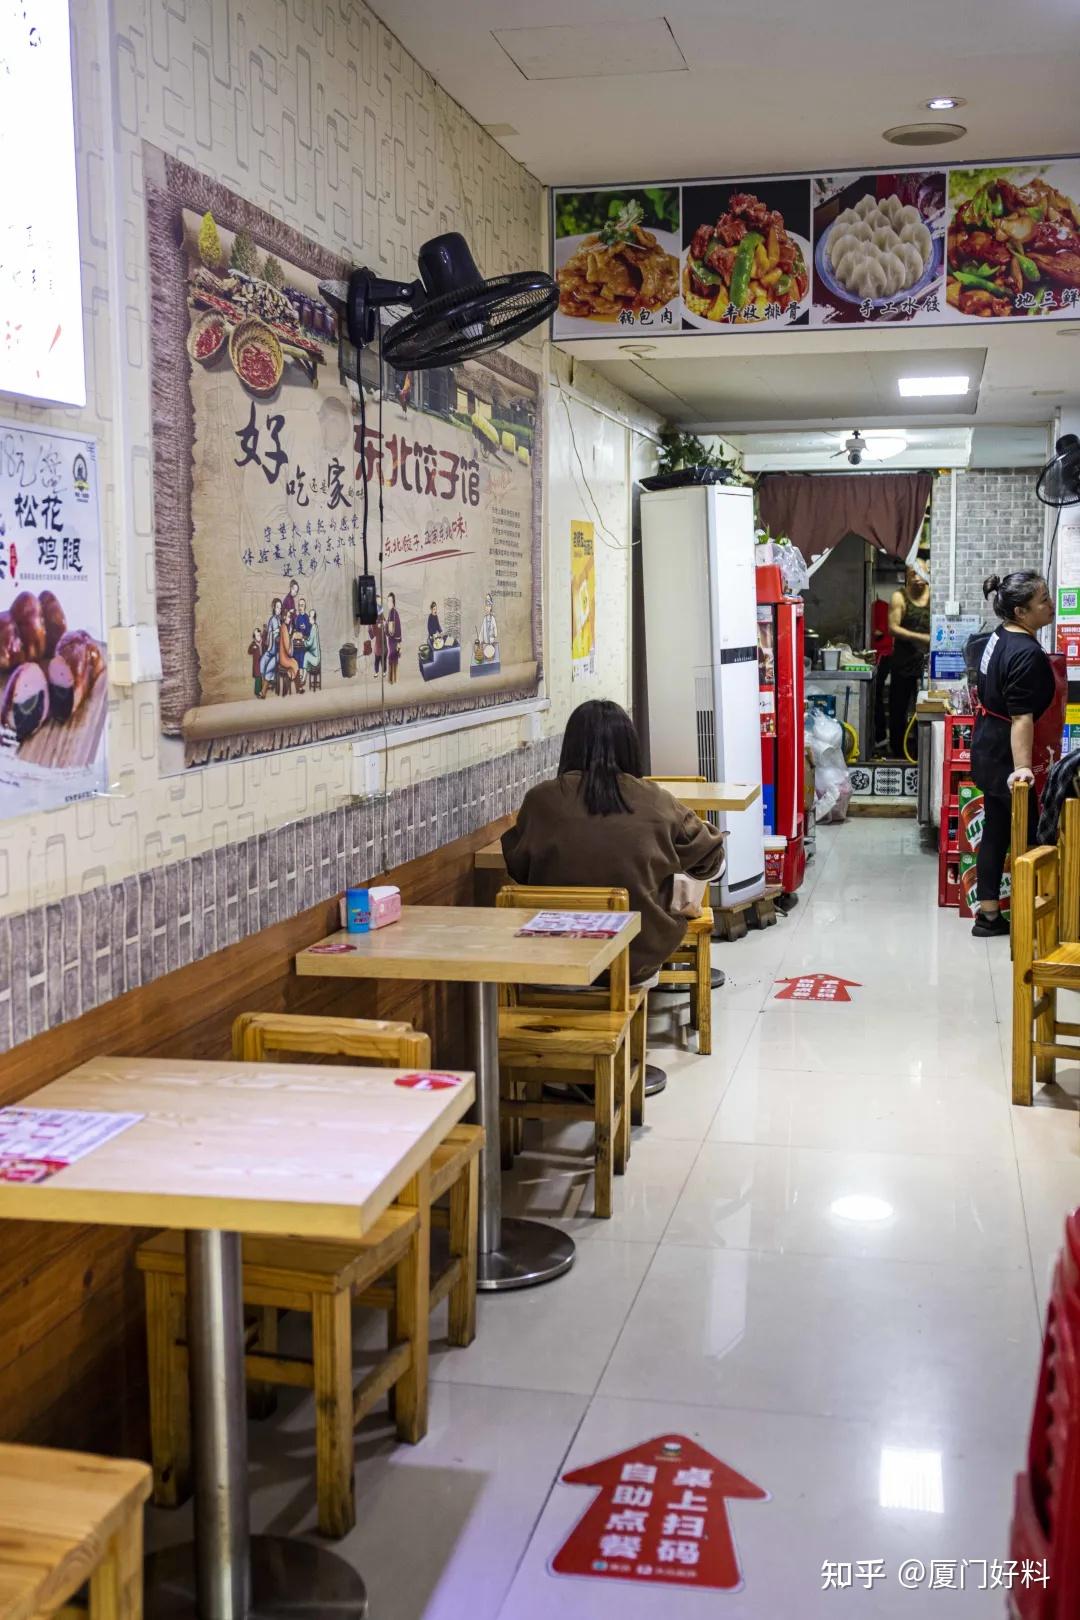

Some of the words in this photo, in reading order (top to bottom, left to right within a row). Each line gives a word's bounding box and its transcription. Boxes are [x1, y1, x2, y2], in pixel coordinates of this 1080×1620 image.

[859, 297, 941, 317] 手工水饺
[1015, 288, 1080, 309] 地三鲜
[617, 307, 674, 327] 锅包肉
[722, 301, 803, 323] 丰收排骨
[353, 424, 481, 507] 东北饺子馆
[14, 493, 64, 532] 松花
[37, 536, 83, 573] 鸡腿
